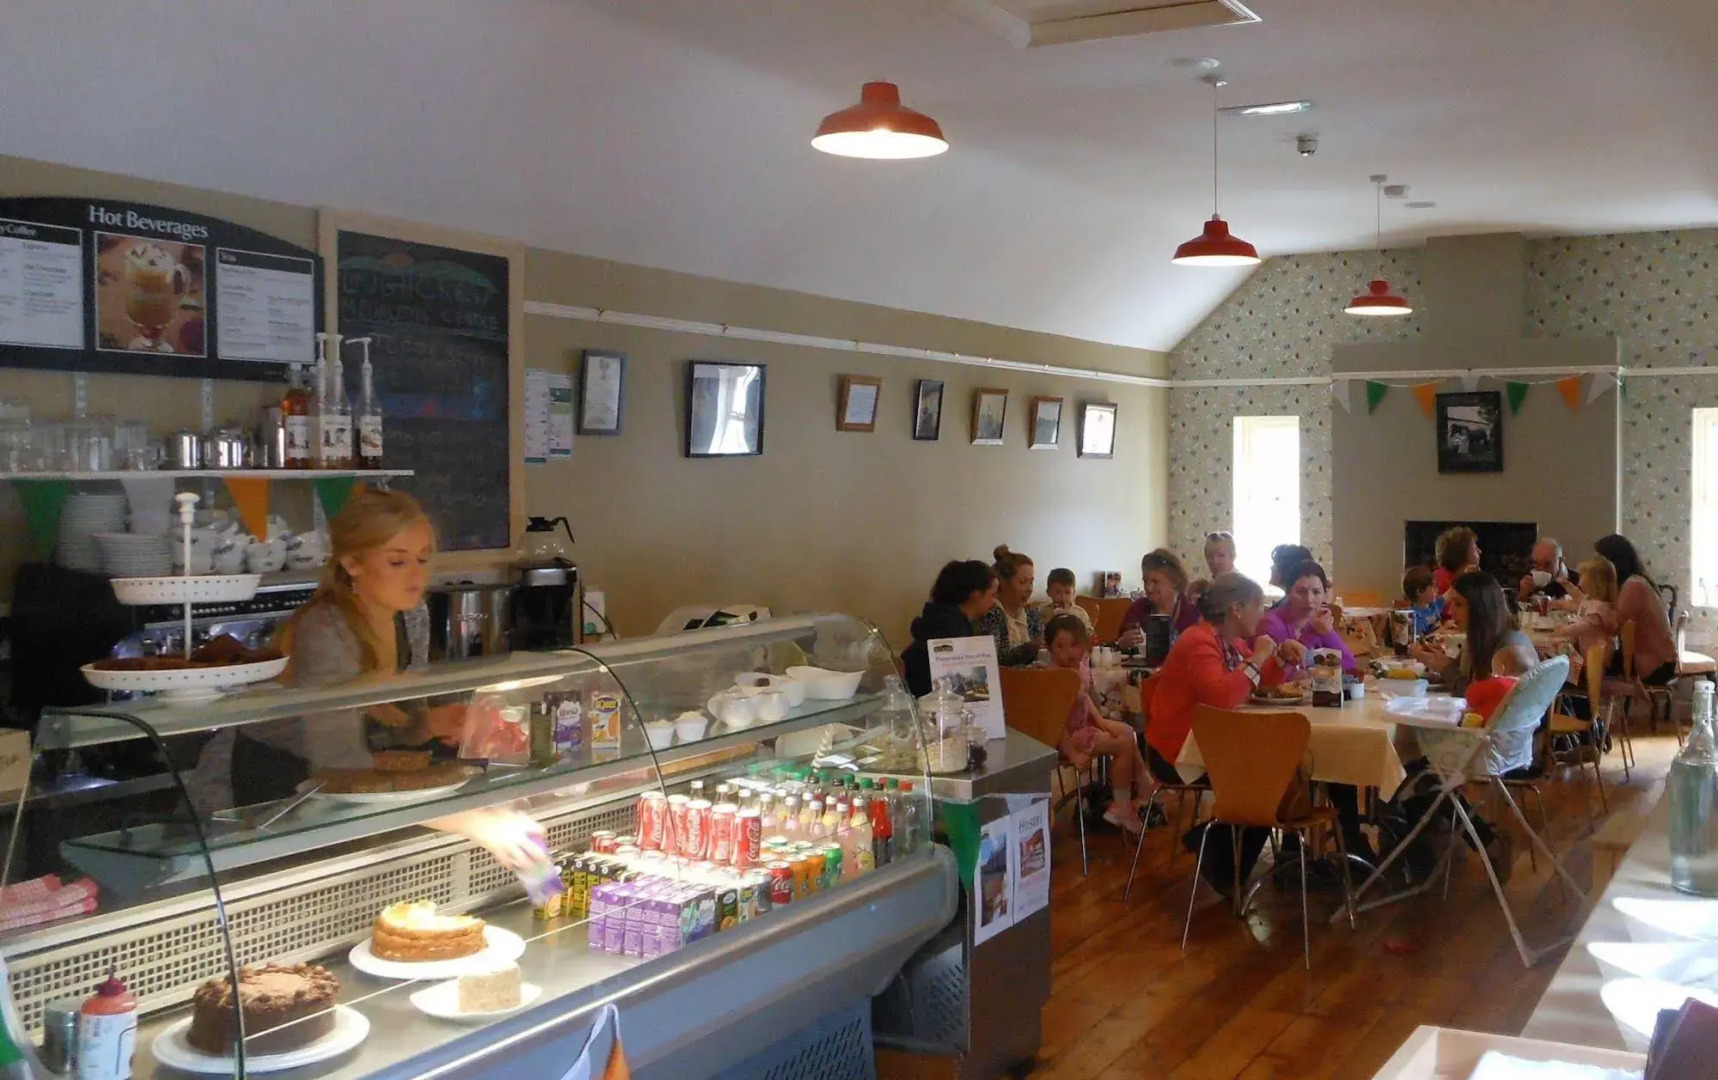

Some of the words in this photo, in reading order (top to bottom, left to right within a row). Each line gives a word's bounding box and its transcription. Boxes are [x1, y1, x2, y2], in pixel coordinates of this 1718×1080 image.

[89, 204, 123, 227] Hot
[126, 210, 208, 240] Beverages
[1018, 810, 1043, 834] Hostel
